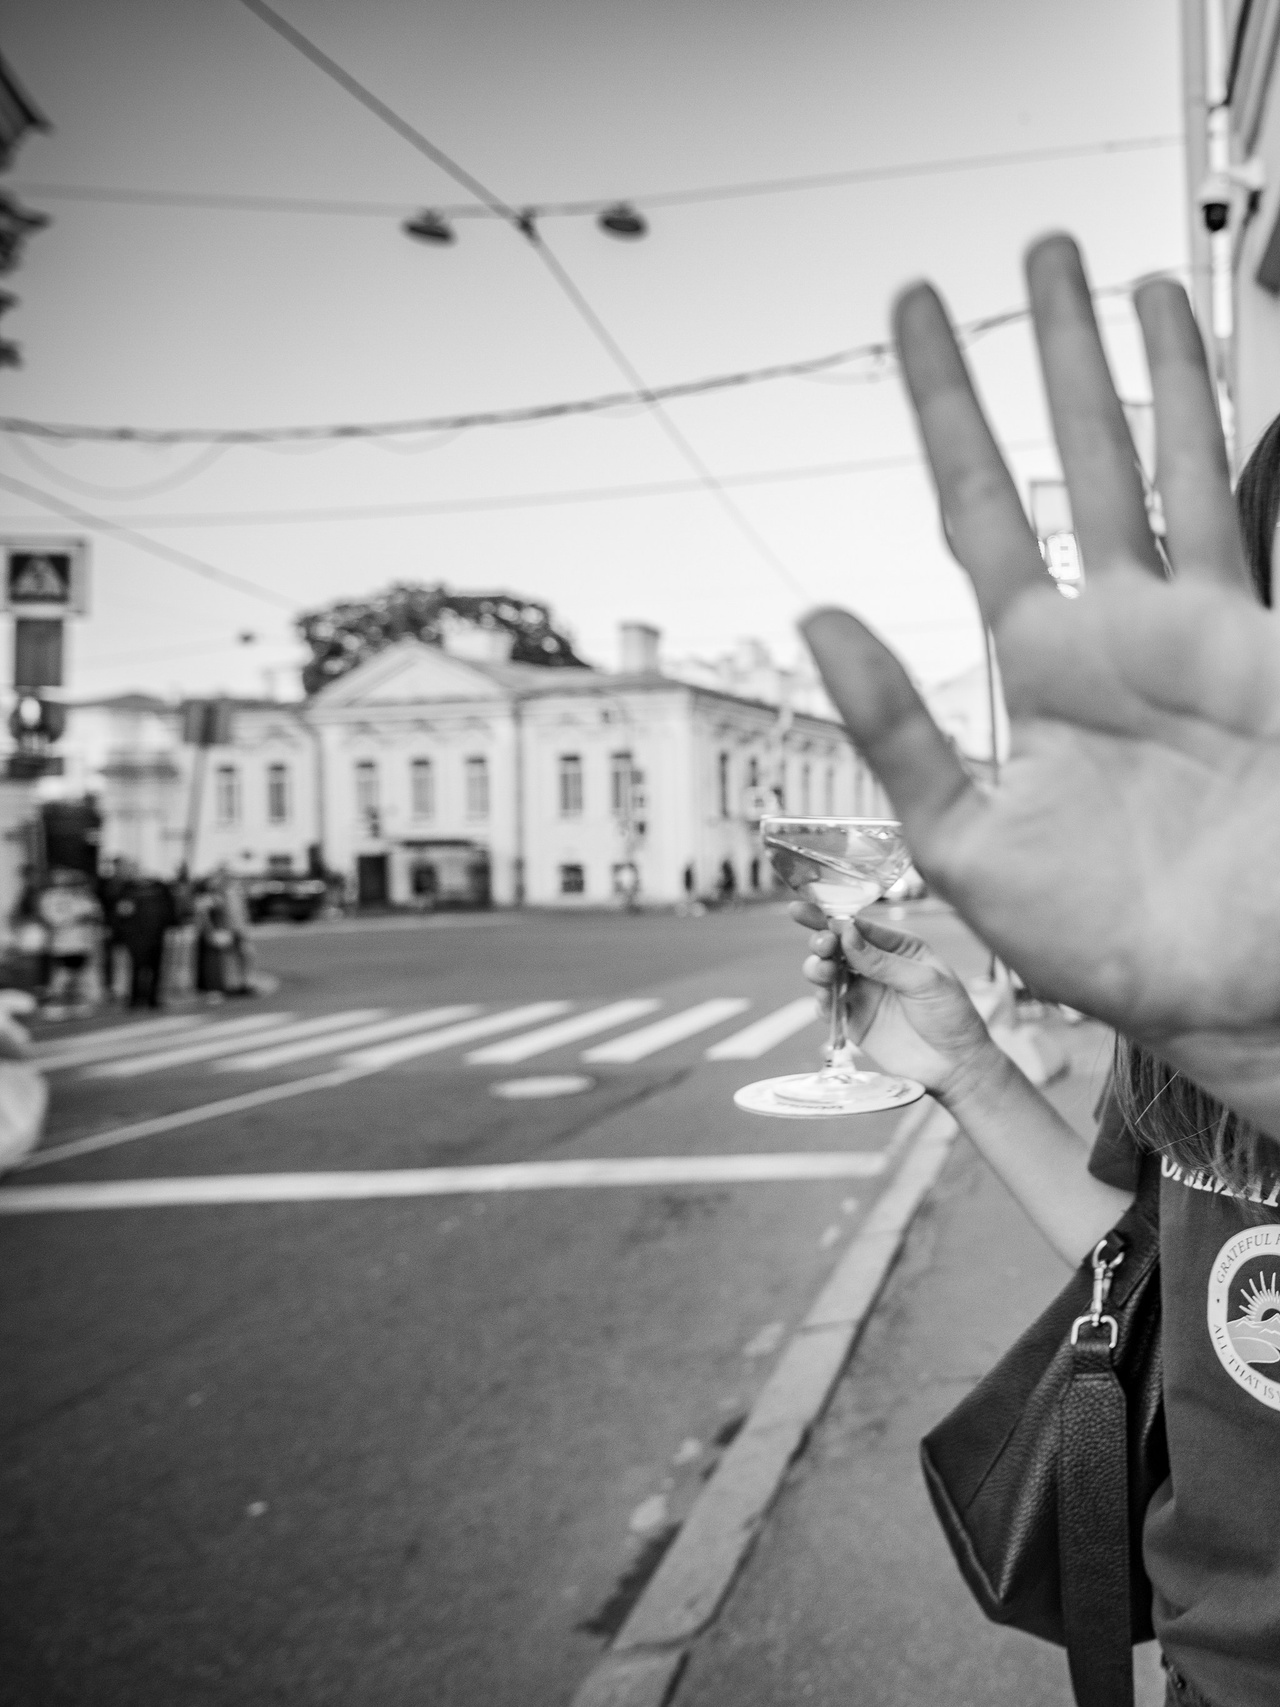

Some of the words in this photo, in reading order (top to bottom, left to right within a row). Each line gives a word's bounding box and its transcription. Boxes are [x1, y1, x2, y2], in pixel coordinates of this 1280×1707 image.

[1216, 1232, 1272, 1285] GRATEFUL
[1213, 1324, 1226, 1355] ALL
[1228, 1354, 1262, 1391] THAT
[1263, 1384, 1275, 1400] IS
